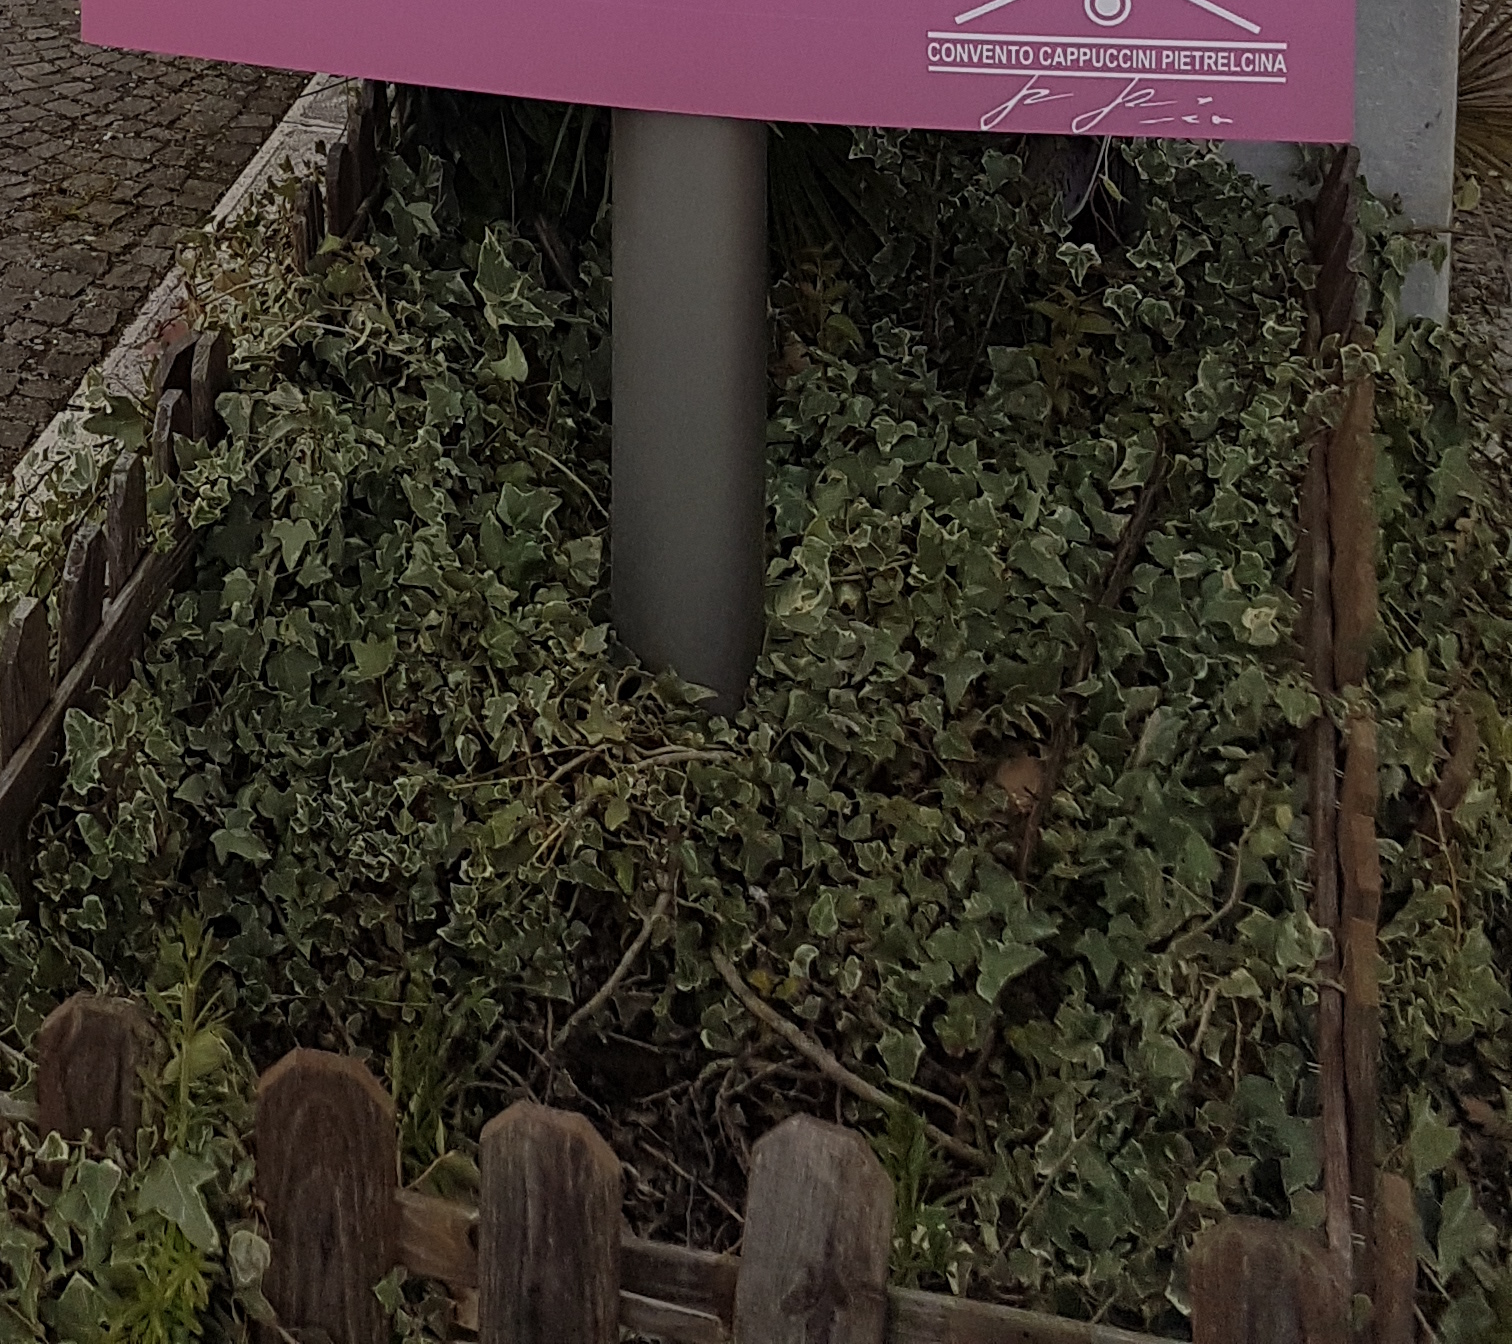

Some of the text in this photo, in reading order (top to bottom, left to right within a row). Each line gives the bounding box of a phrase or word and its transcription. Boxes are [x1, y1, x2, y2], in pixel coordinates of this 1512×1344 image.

[927, 42, 1287, 73] CONVENTO CAPPUCCINI PIETRELCINA
